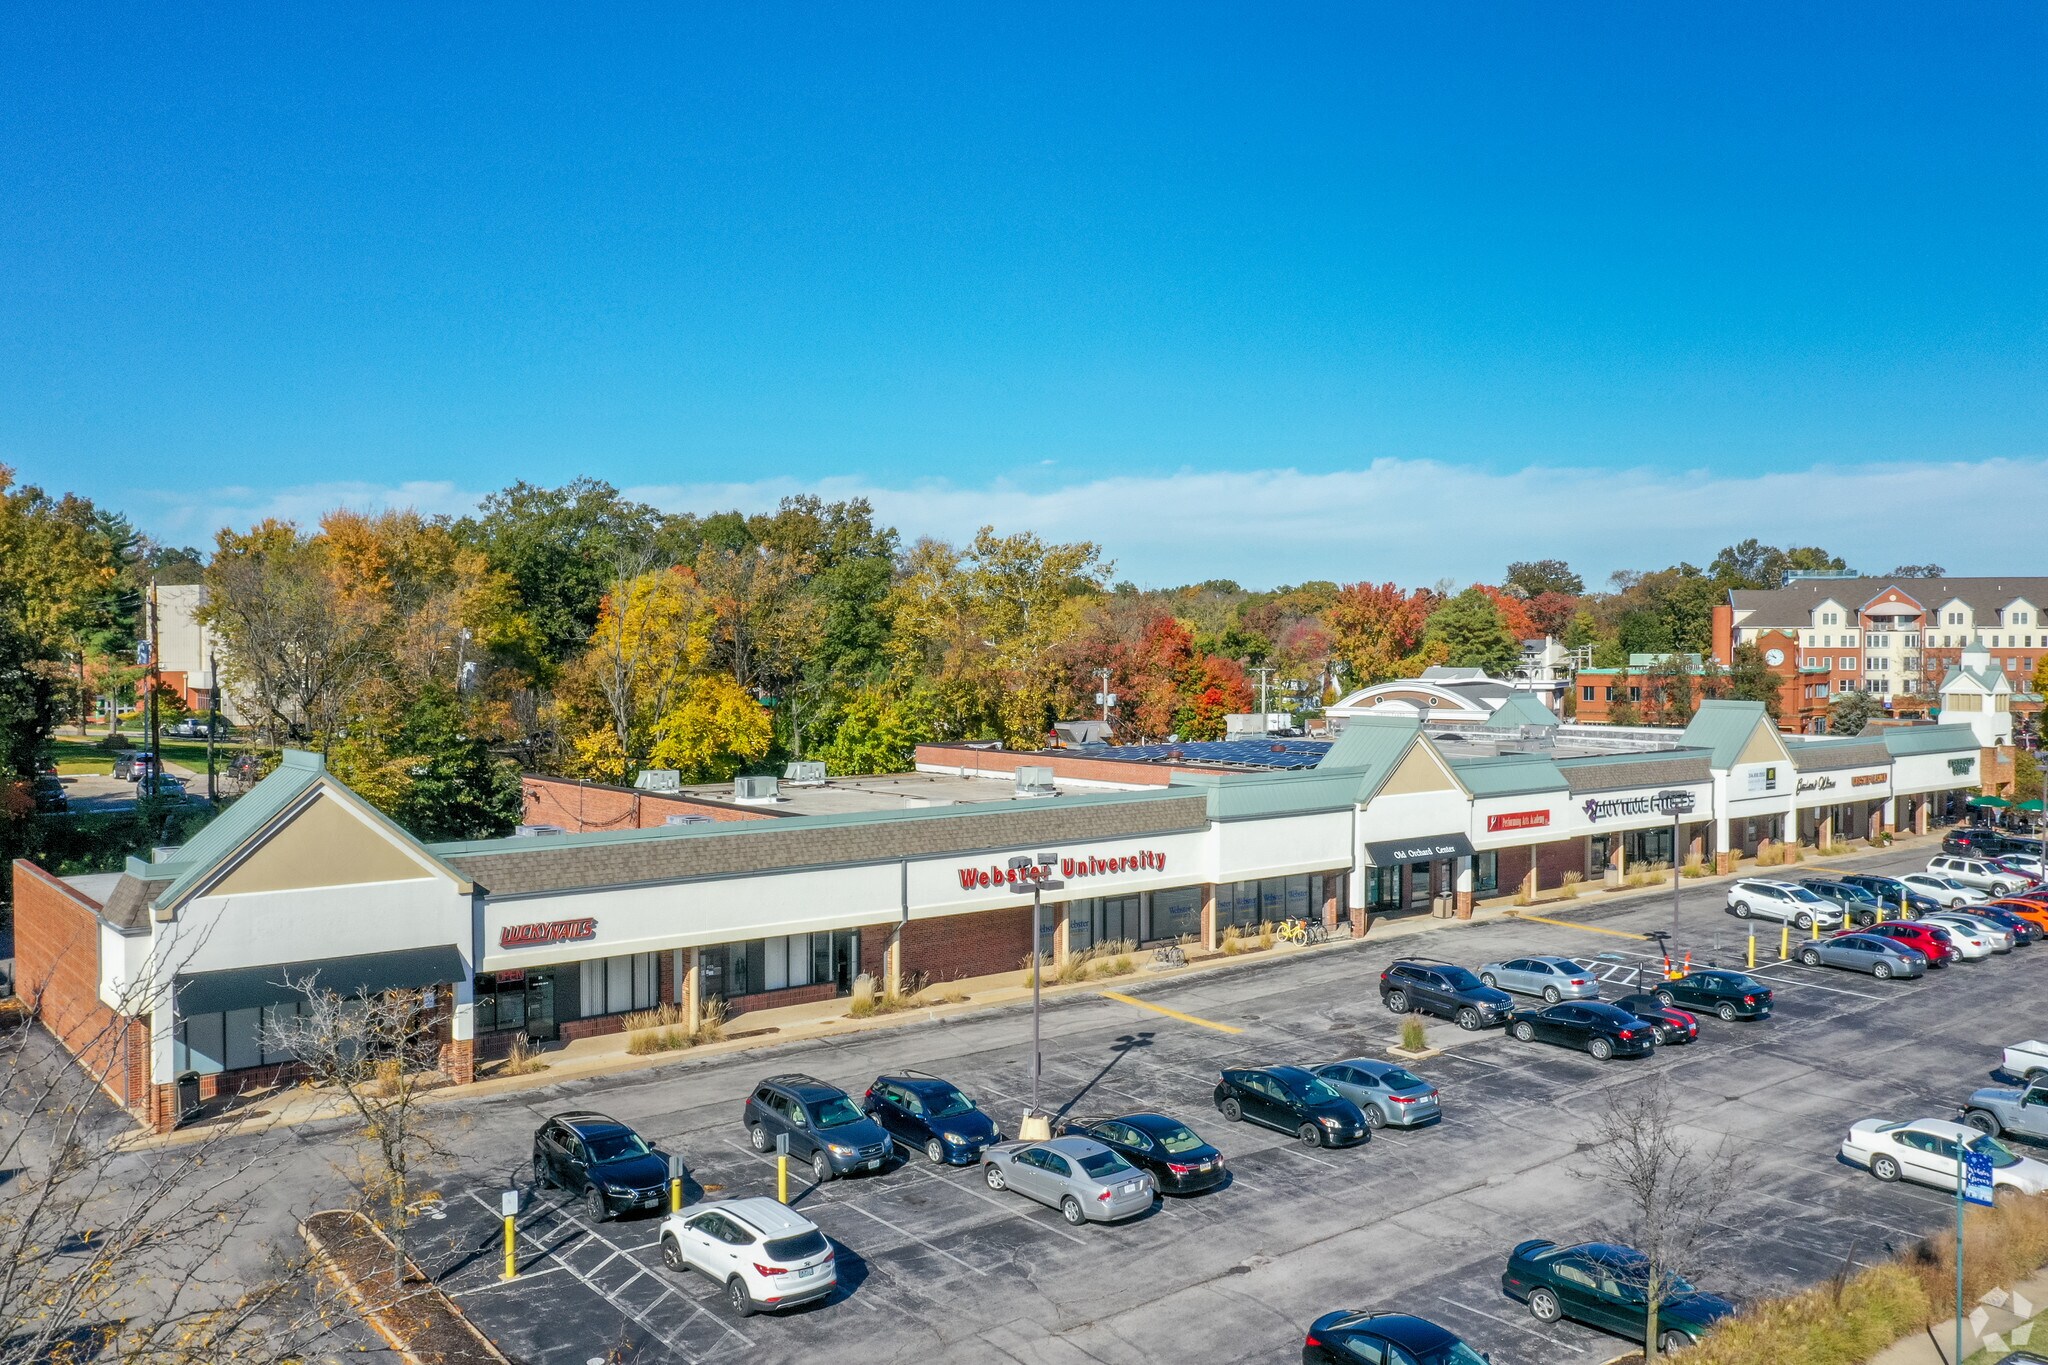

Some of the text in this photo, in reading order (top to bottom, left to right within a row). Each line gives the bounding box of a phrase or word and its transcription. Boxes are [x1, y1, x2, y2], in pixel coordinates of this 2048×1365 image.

[1595, 791, 1696, 818] ANYTIME FITSS
[1393, 846, 1456, 859] Old Orchard Center
[958, 850, 1167, 888] Webster University
[499, 918, 594, 946] LUCKY NAILS
[1070, 920, 1089, 929] ebster
[496, 969, 525, 983] OPEN
